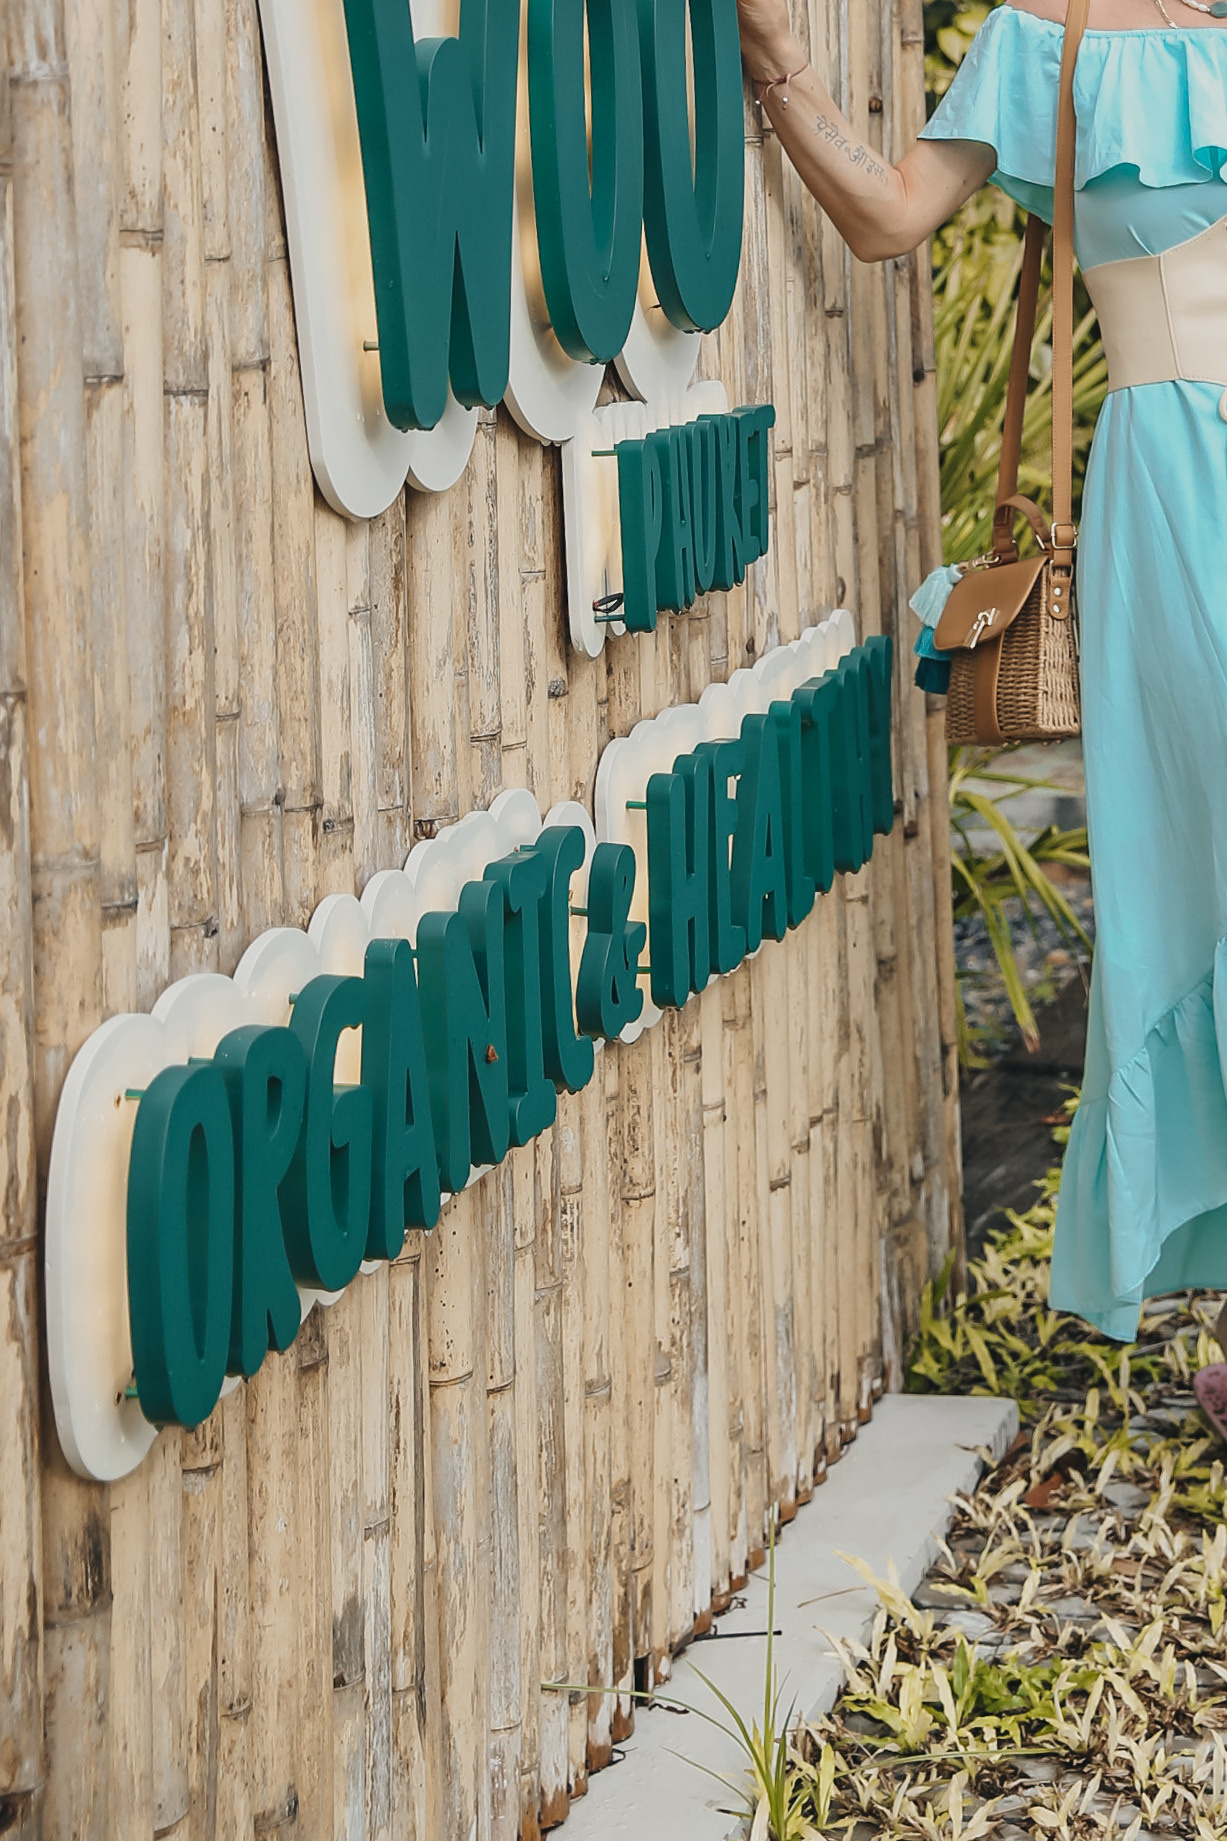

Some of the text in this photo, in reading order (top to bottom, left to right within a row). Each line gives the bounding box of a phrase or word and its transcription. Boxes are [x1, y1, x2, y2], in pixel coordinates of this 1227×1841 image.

[615, 404, 776, 634] PHUKET
[126, 634, 894, 1431] ORGANIC & HEALTHY
